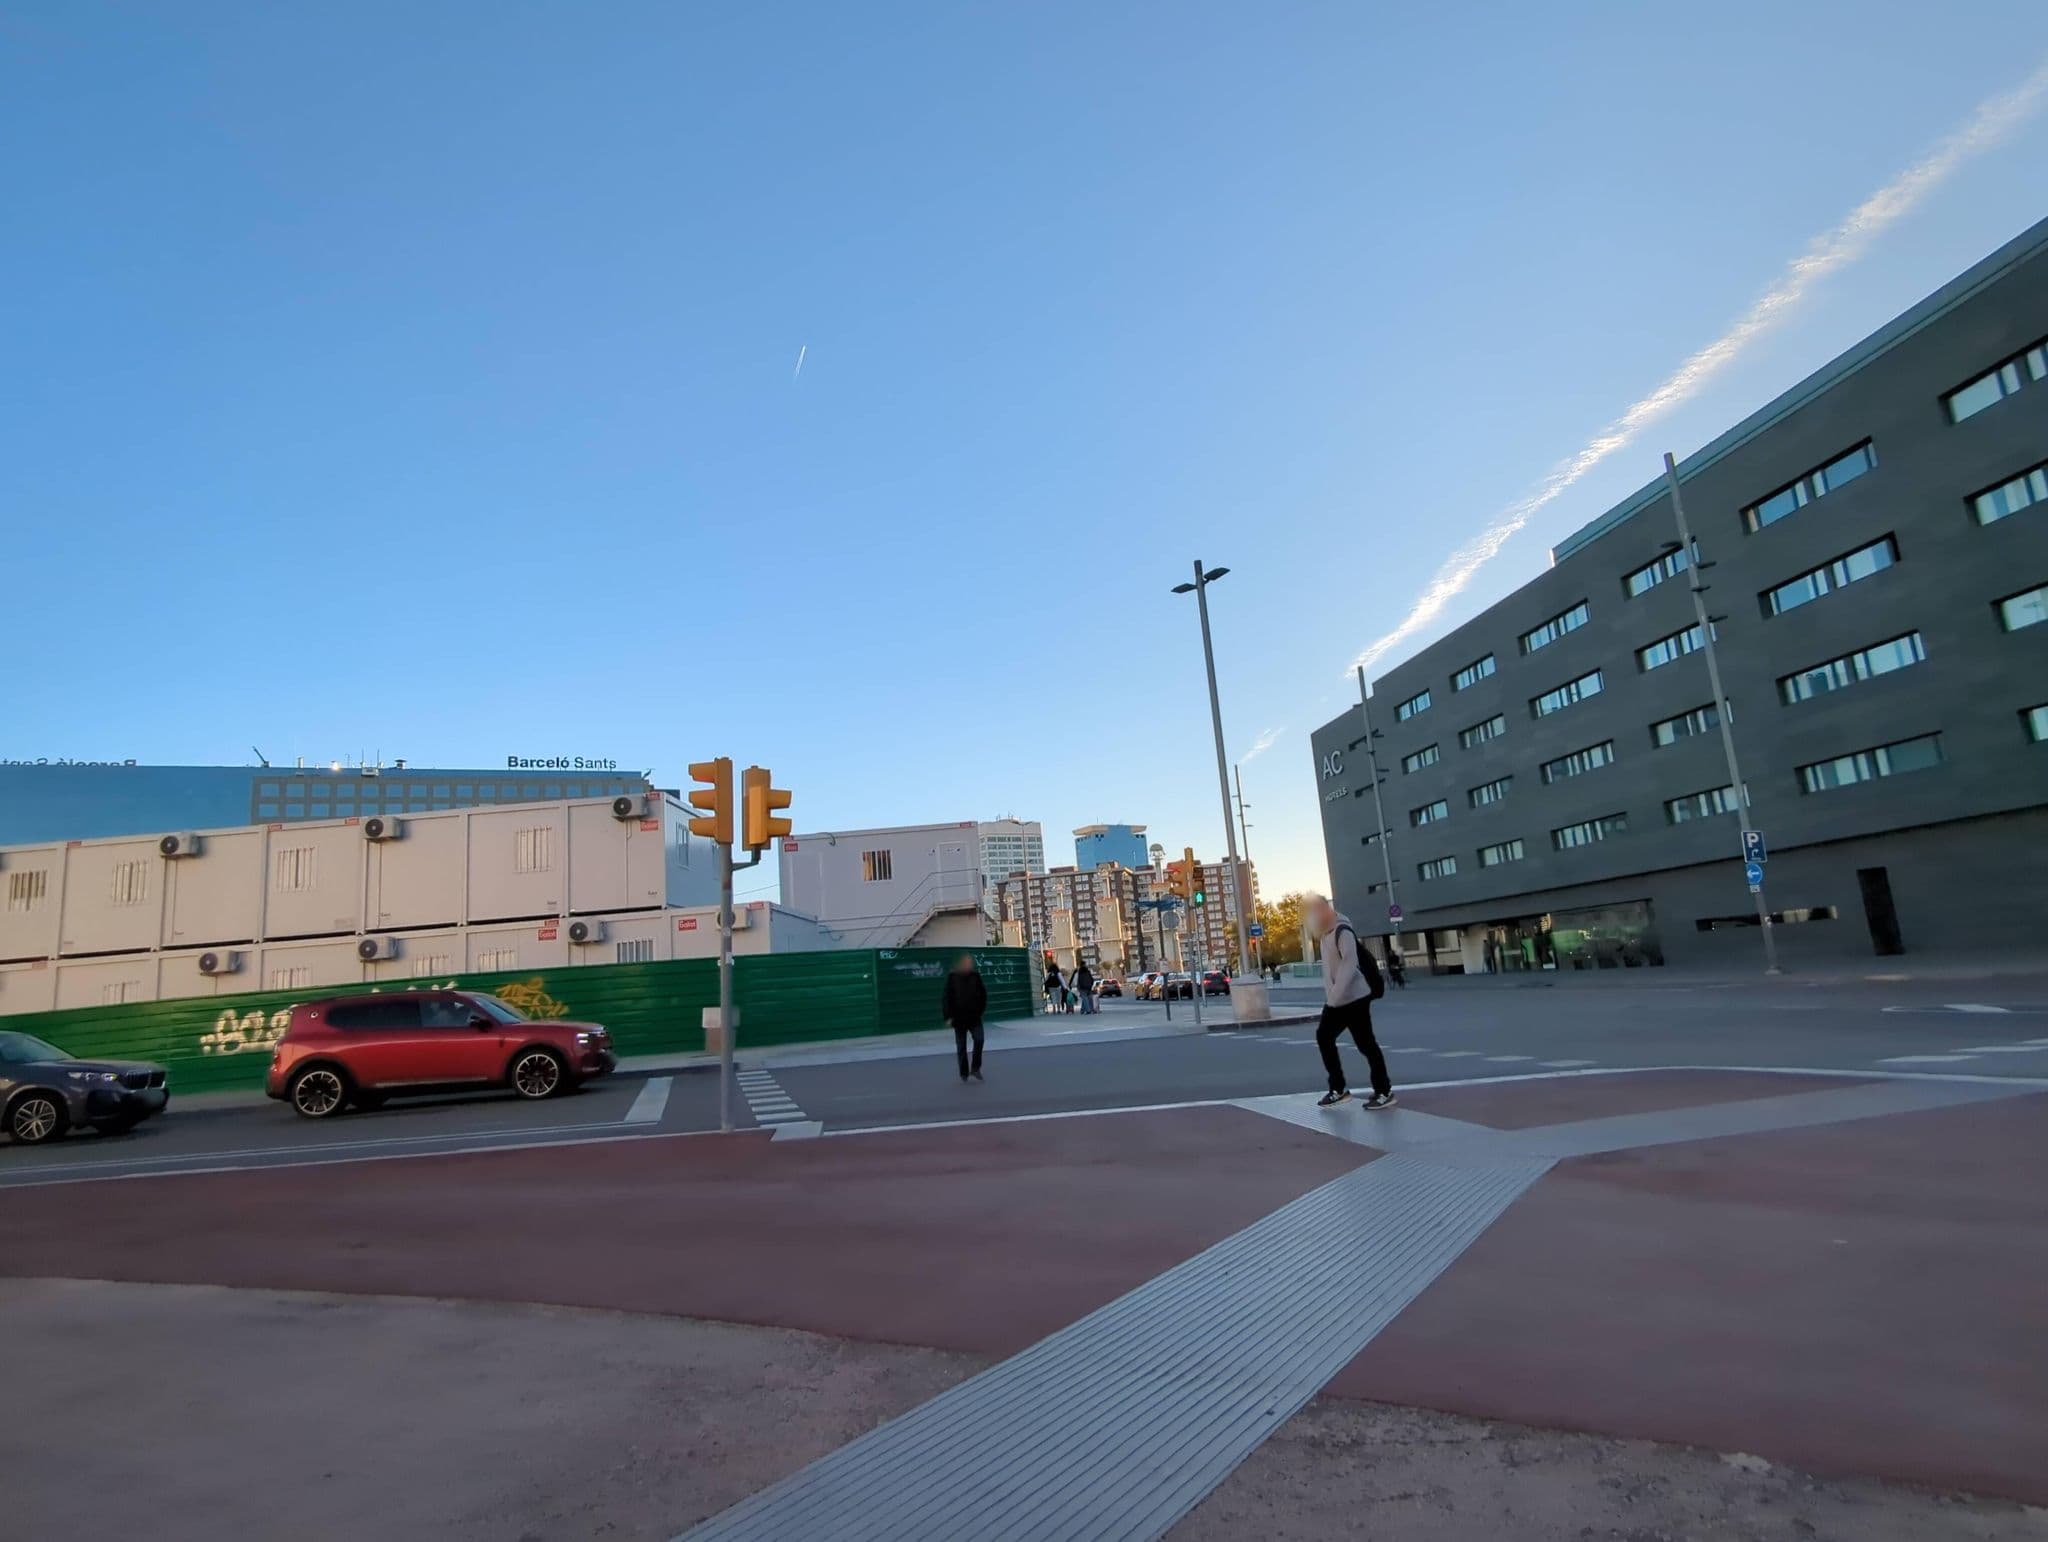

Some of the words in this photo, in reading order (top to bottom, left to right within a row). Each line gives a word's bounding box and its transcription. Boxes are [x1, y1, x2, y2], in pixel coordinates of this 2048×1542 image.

[507, 756, 570, 768] Barceló
[574, 756, 617, 769] Sants
[1323, 751, 1343, 779] AC
[1747, 832, 1759, 848] P
